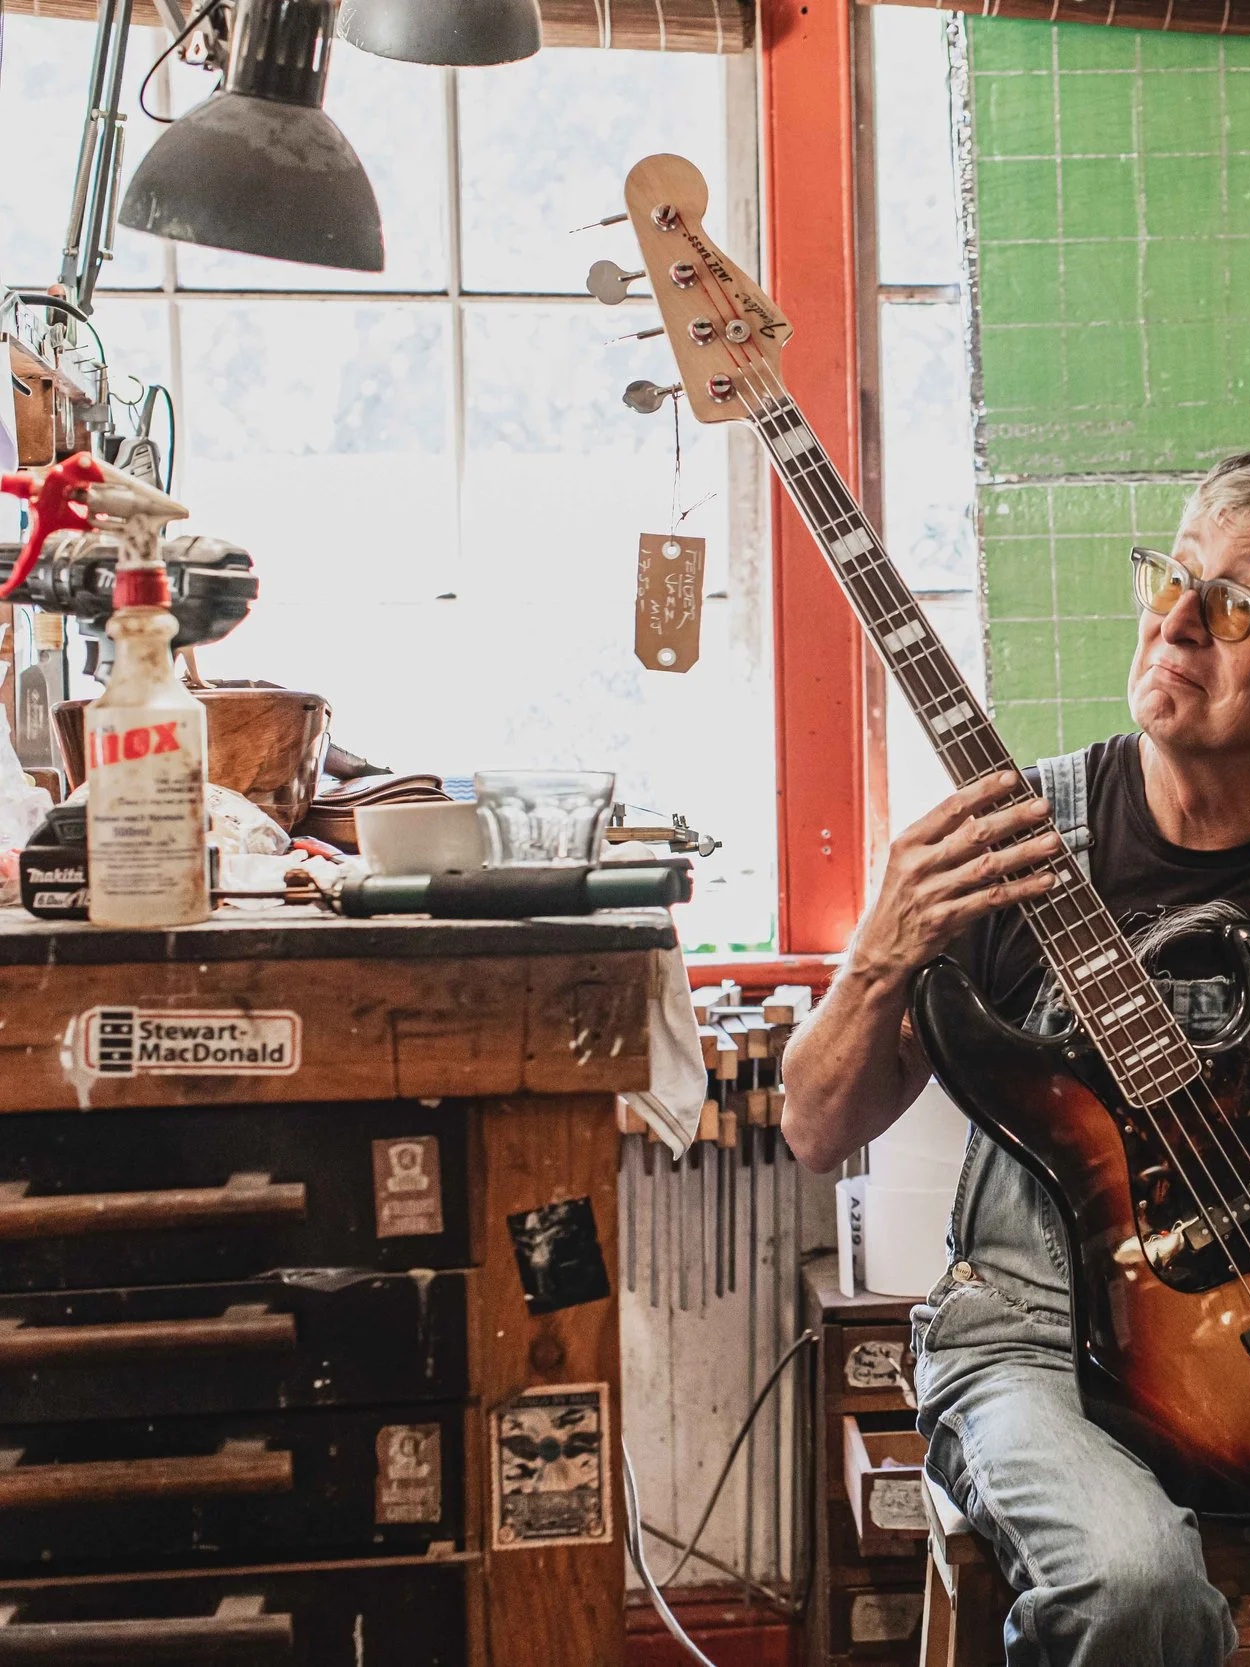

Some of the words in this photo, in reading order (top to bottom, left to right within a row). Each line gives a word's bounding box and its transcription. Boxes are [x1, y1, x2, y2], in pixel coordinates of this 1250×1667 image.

[688, 235, 711, 258] BASS
[708, 261, 732, 283] JAZZ
[742, 292, 787, 338] Fender
[676, 549, 699, 629] FENDER
[138, 1020, 248, 1040] Stewart-
[138, 1042, 285, 1063] MacDonald
